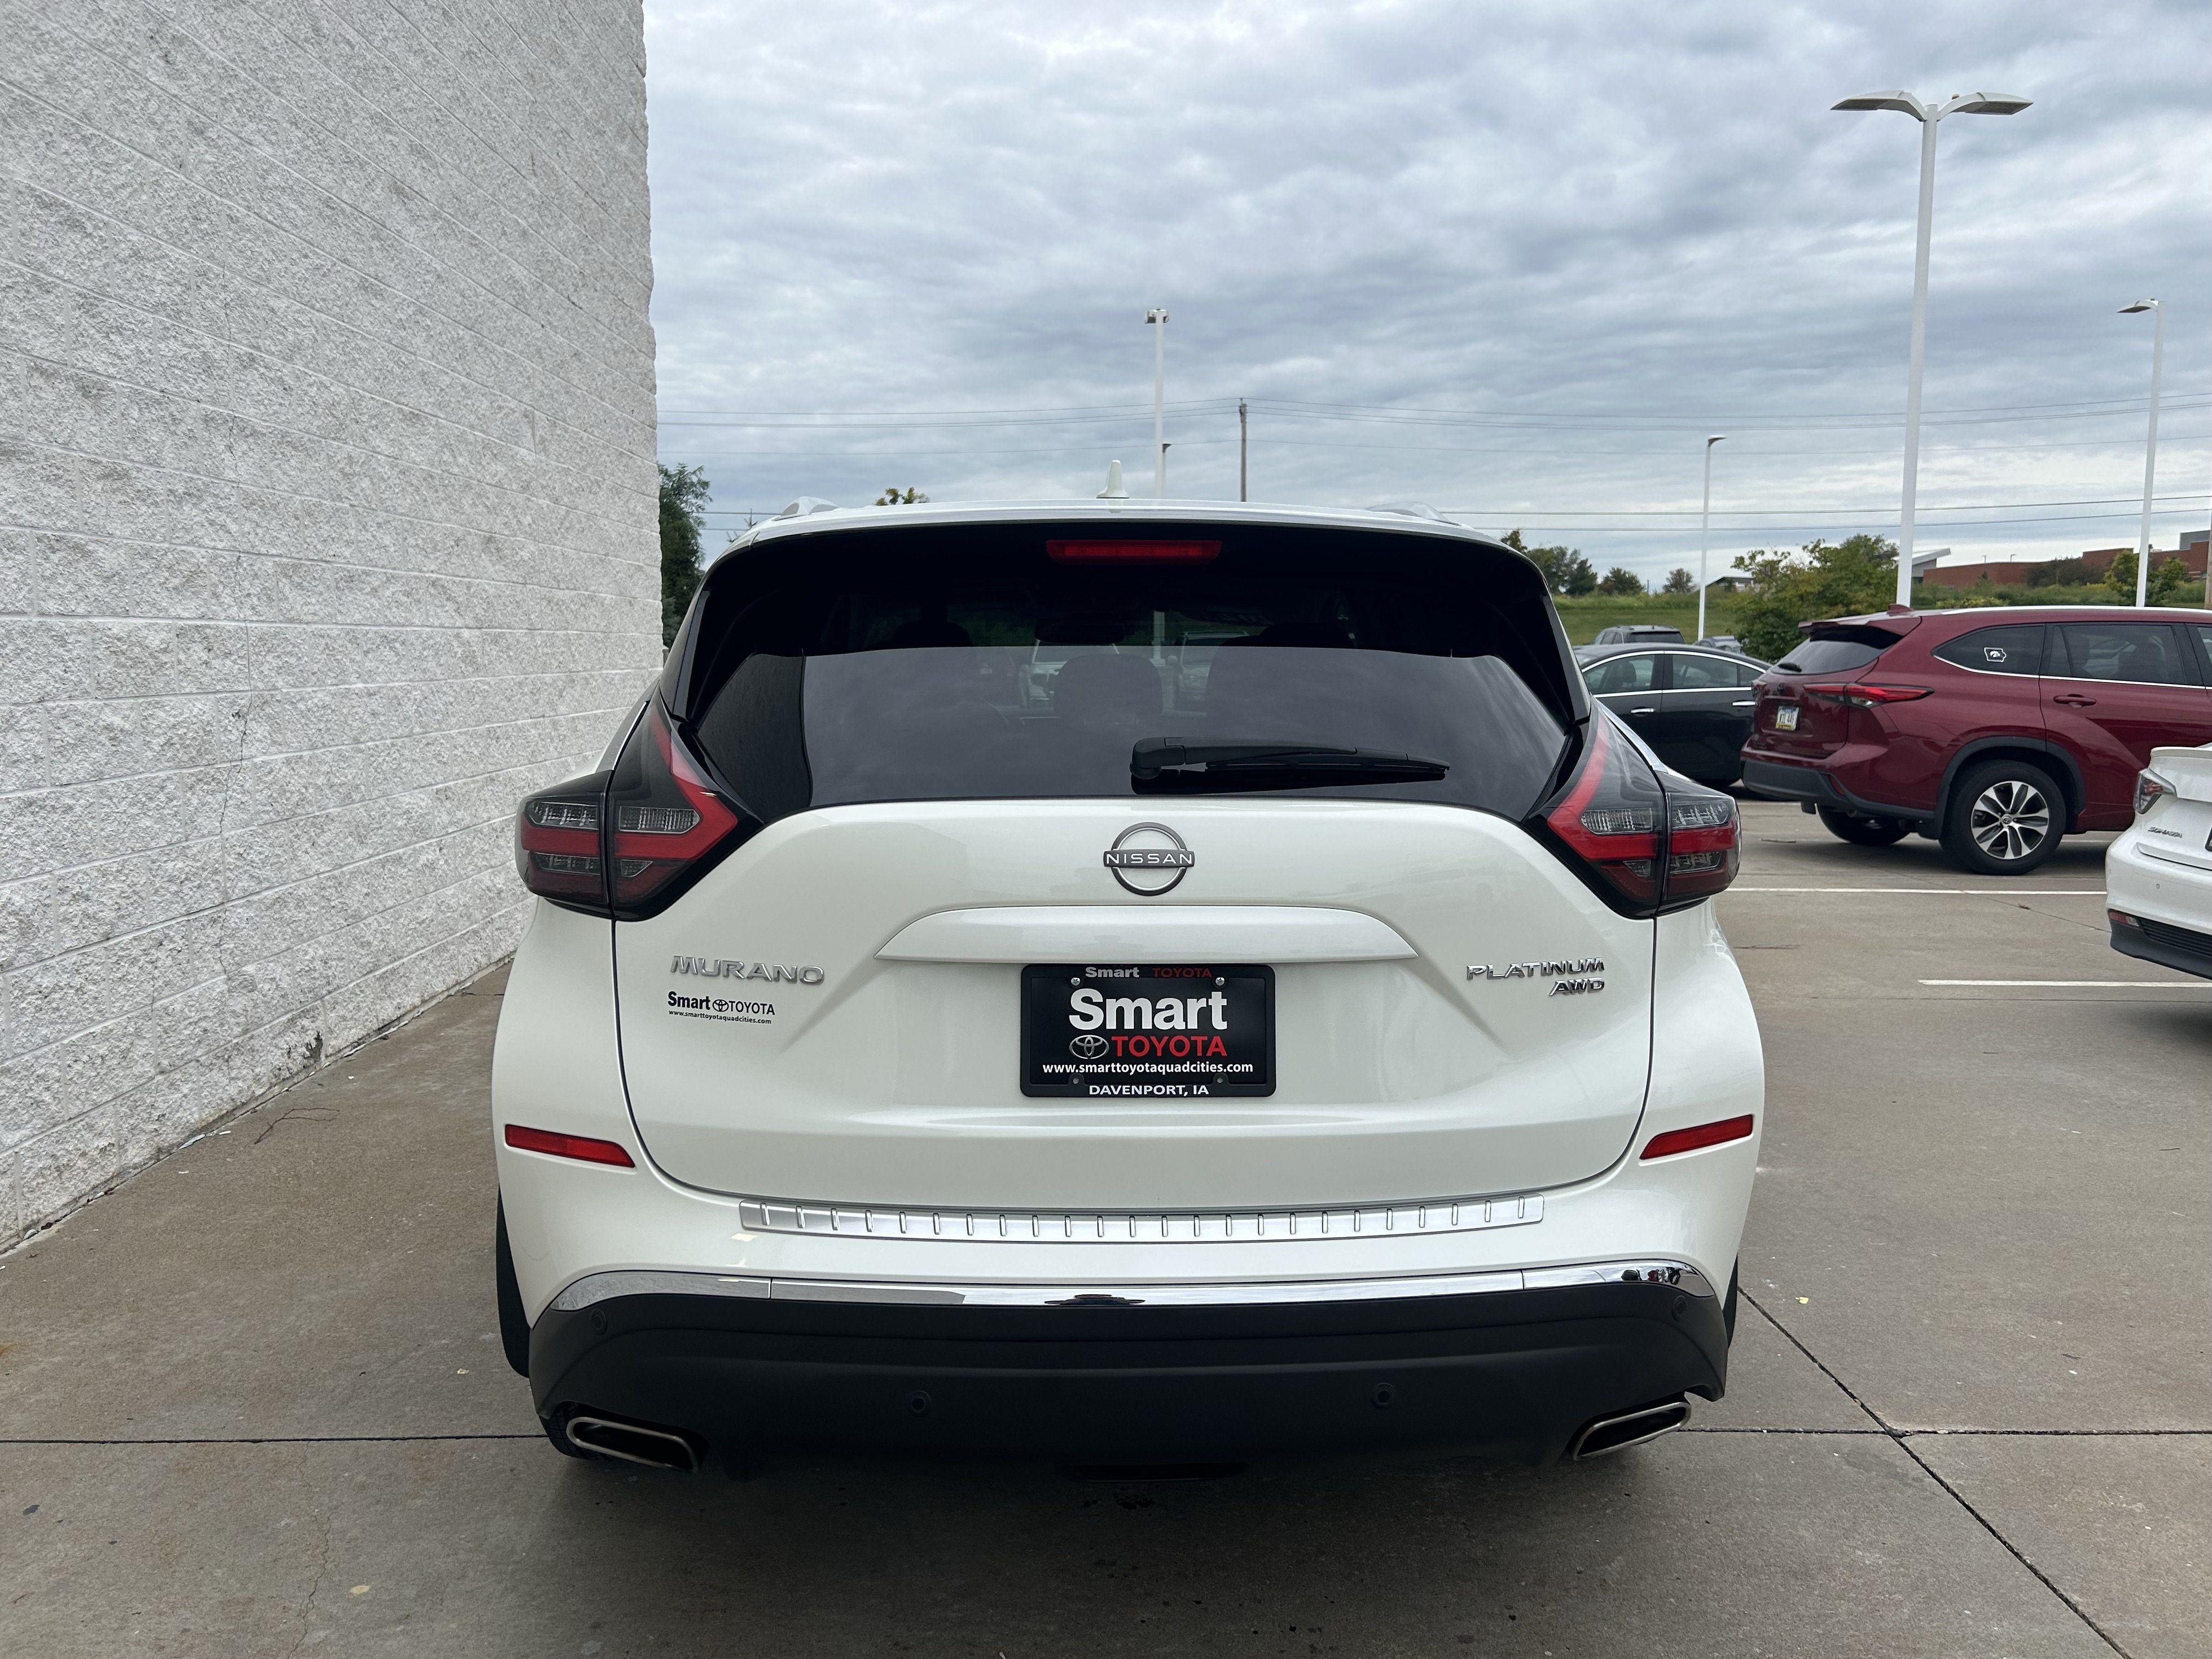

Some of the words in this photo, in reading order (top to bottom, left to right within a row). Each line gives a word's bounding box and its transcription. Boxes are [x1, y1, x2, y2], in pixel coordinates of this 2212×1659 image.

[1106, 853, 1192, 864] NISSAN
[670, 955, 825, 985] MURANO
[1085, 967, 1139, 978] Smart
[1153, 968, 1212, 978] TOYOTA
[1466, 957, 1605, 980] PLATINUM
[1548, 977, 1605, 996] AWD
[668, 991, 711, 1011] Smart
[729, 1000, 775, 1015] TOYOTA
[1069, 988, 1228, 1030] Smart
[669, 1011, 771, 1024] www.smarttoyotaquadcities.com
[1111, 1035, 1228, 1057] TOYOTA
[1042, 1061, 1254, 1075] www.smarttoyotaquadcities.com
[1089, 1085, 1188, 1096] DAVENPORT,
[1193, 1085, 1209, 1095] IA
